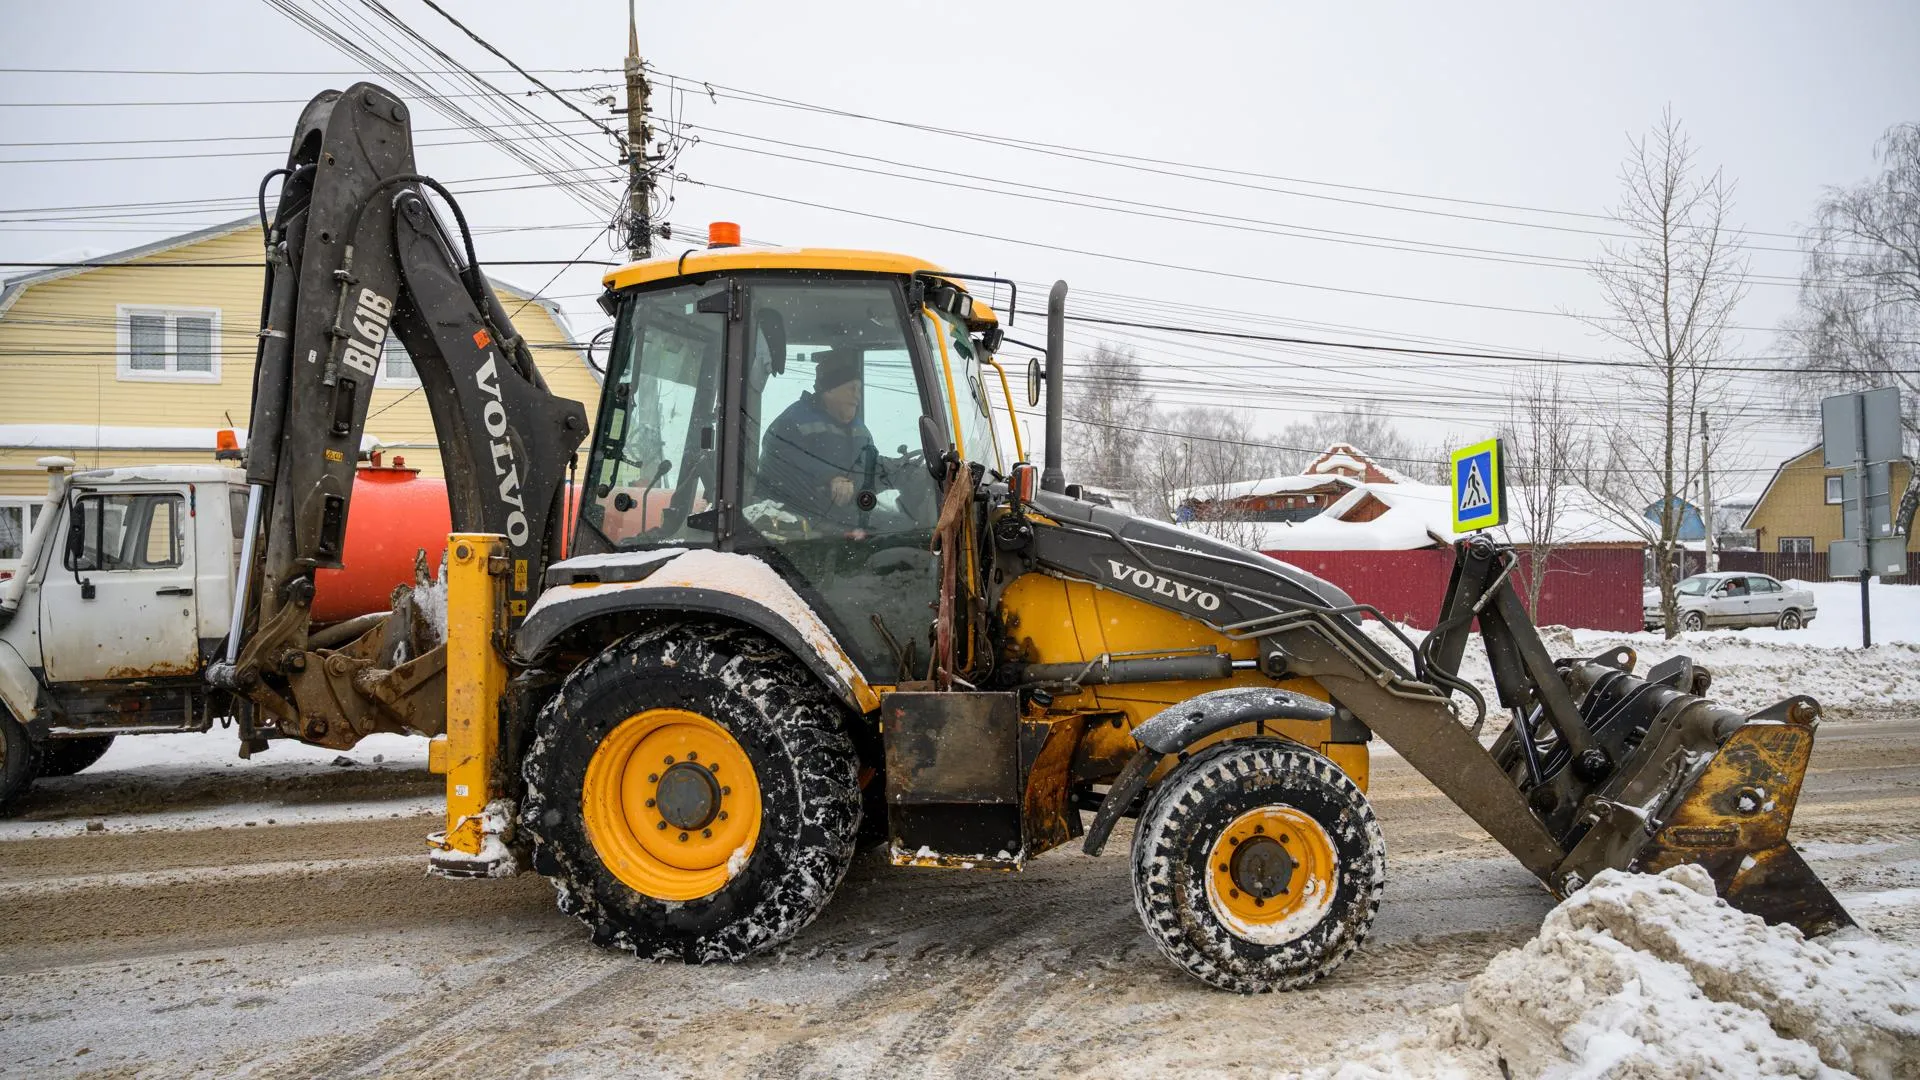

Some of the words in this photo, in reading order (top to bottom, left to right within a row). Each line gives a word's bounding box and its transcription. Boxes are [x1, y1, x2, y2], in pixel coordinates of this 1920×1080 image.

[343, 288, 393, 376] BL61B
[475, 352, 529, 547] VOLVO
[1108, 559, 1220, 611] VOLVO
